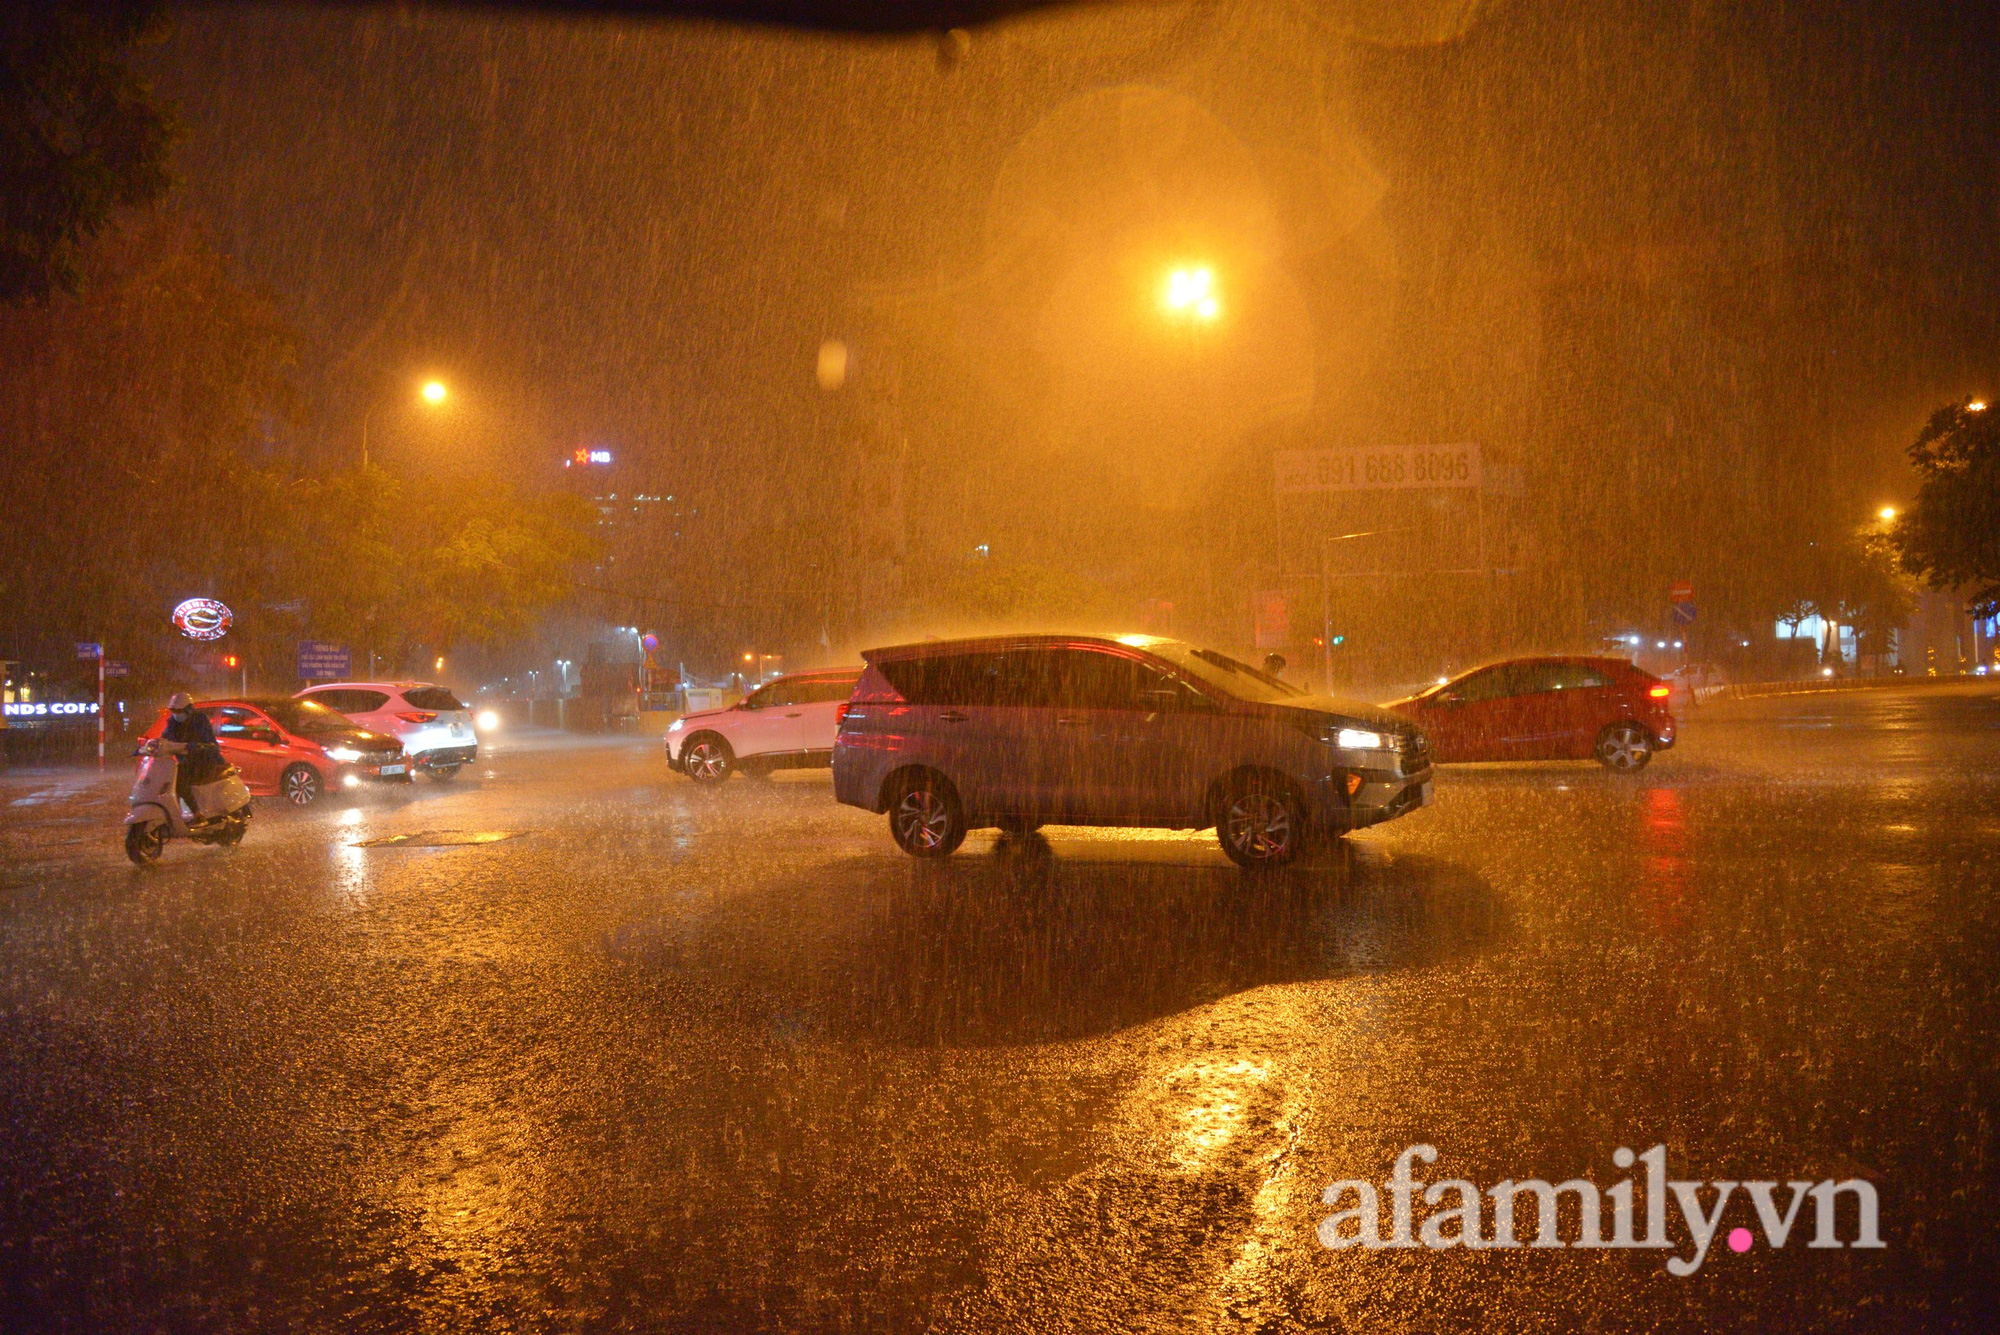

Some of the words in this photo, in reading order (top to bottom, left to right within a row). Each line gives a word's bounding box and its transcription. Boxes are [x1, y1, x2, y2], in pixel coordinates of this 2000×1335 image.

[590, 451, 611, 462] MB
[1413, 451, 1469, 482] 8096
[4, 703, 48, 716] NDS
